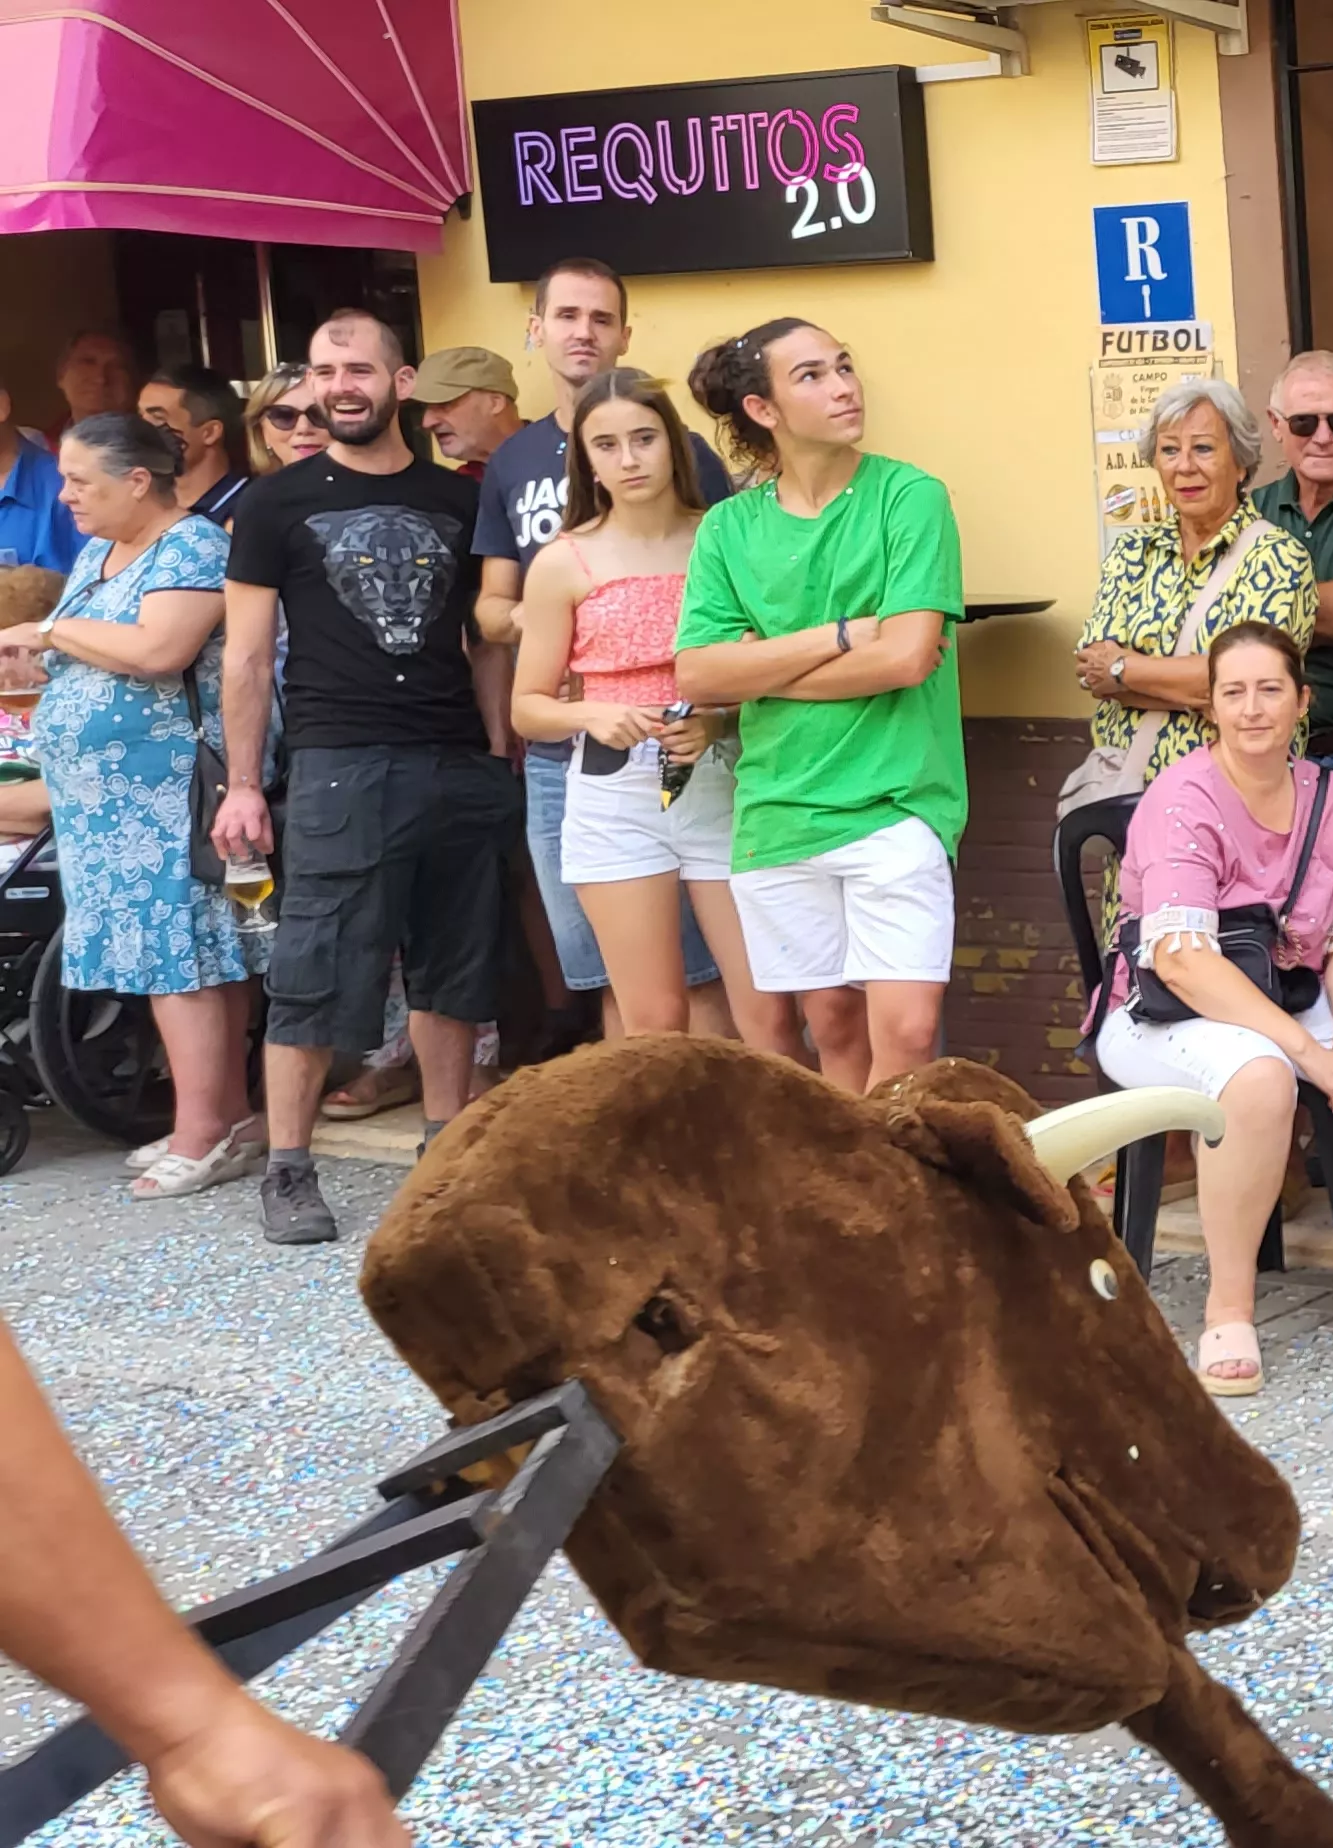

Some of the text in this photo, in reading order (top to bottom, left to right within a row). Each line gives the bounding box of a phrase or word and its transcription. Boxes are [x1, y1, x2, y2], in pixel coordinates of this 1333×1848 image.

[785, 162, 877, 239] 2.0
[1120, 216, 1168, 282] R
[1102, 328, 1207, 357] FUTBOL
[1132, 372, 1168, 383] CAMPO
